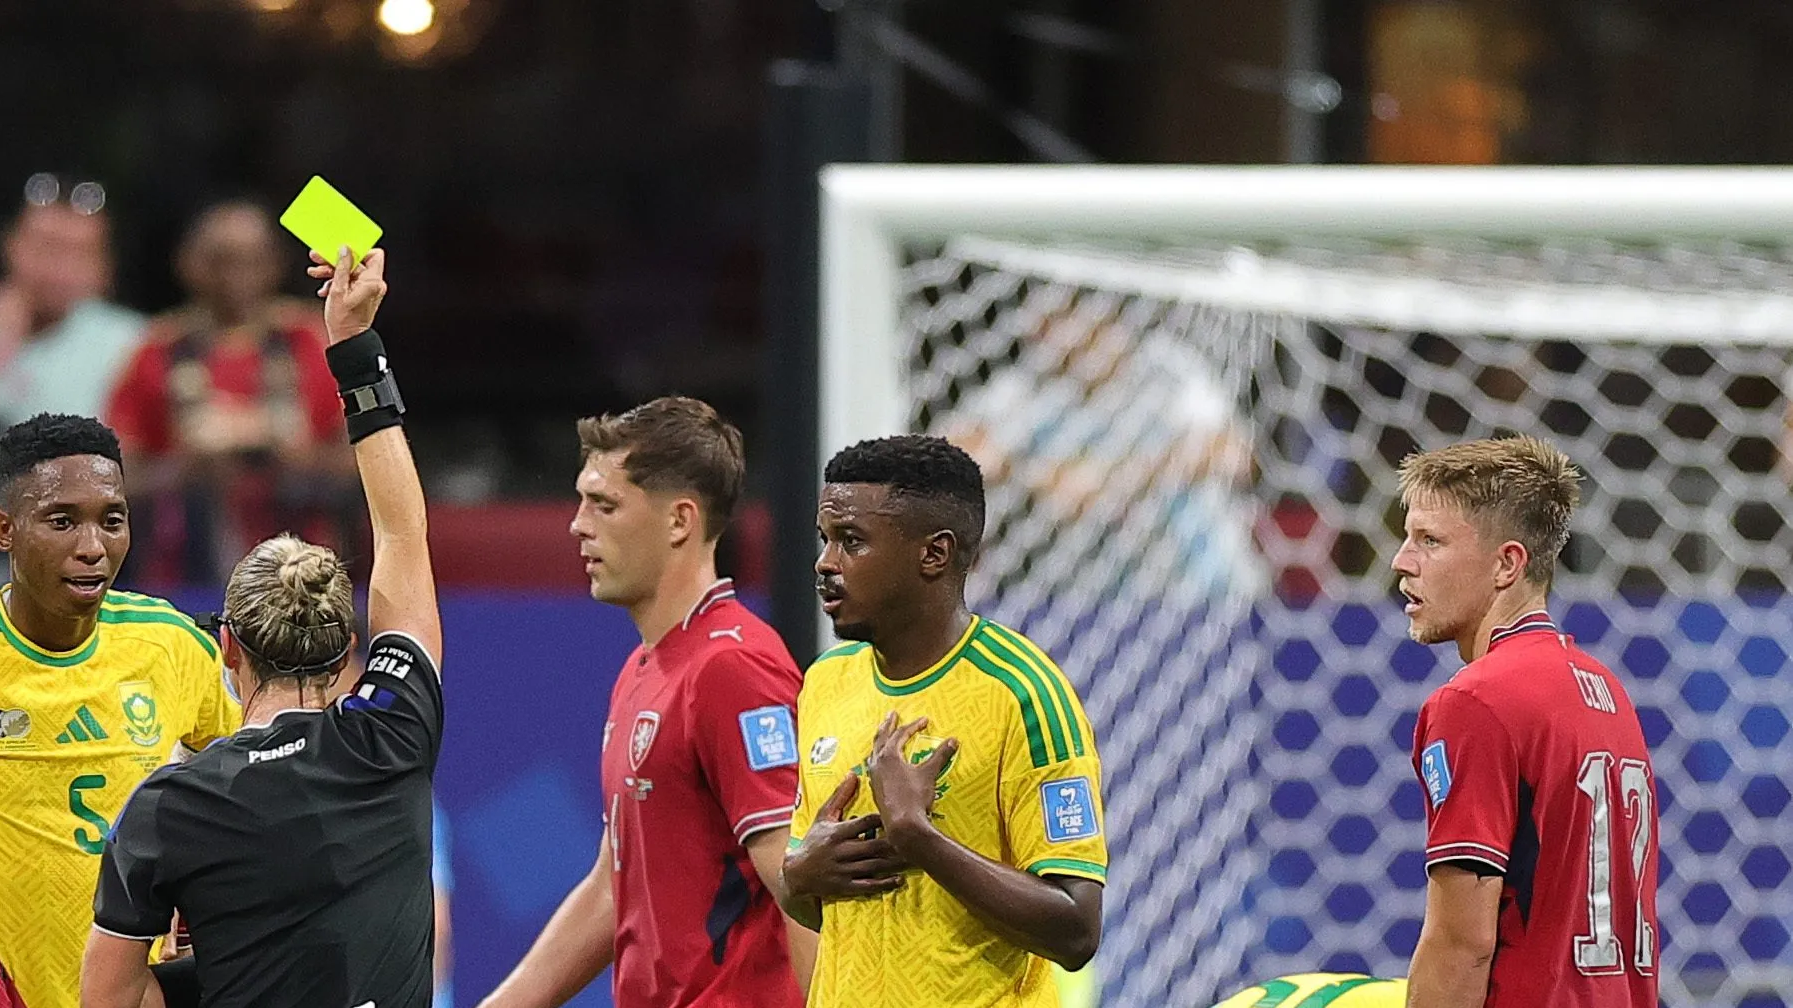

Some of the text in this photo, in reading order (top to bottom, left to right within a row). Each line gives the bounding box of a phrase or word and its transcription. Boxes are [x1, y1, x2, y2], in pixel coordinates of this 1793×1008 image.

[248, 737, 307, 764] PENSO
[68, 774, 112, 855] 5
[1573, 749, 1656, 979] 12
